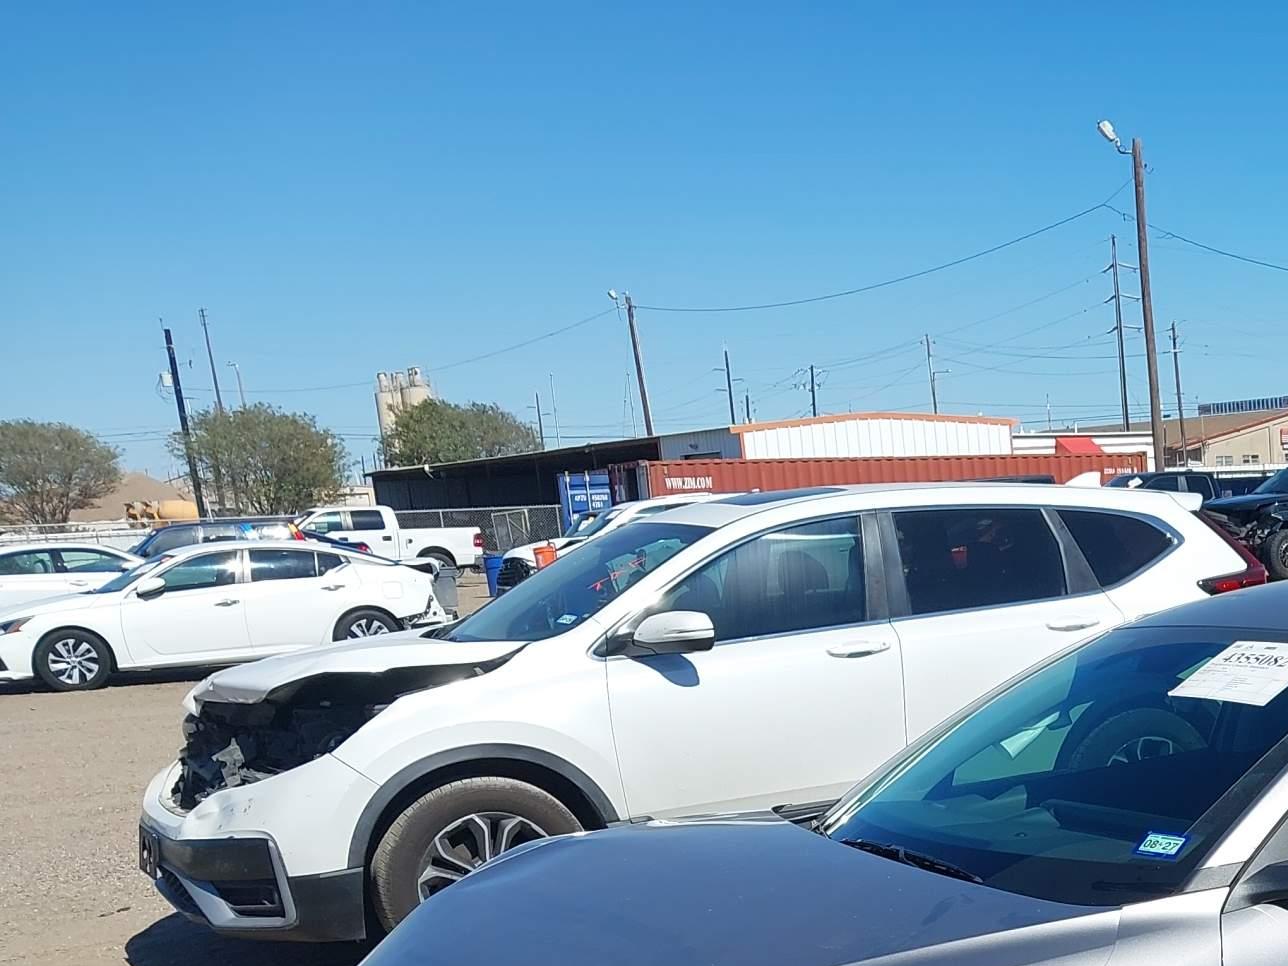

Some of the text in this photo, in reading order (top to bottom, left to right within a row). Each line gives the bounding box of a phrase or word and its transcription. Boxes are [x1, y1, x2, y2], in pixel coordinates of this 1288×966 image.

[665, 476, 712, 489] WWW.ZIM.COM
[1143, 839, 1180, 850] 08 27
